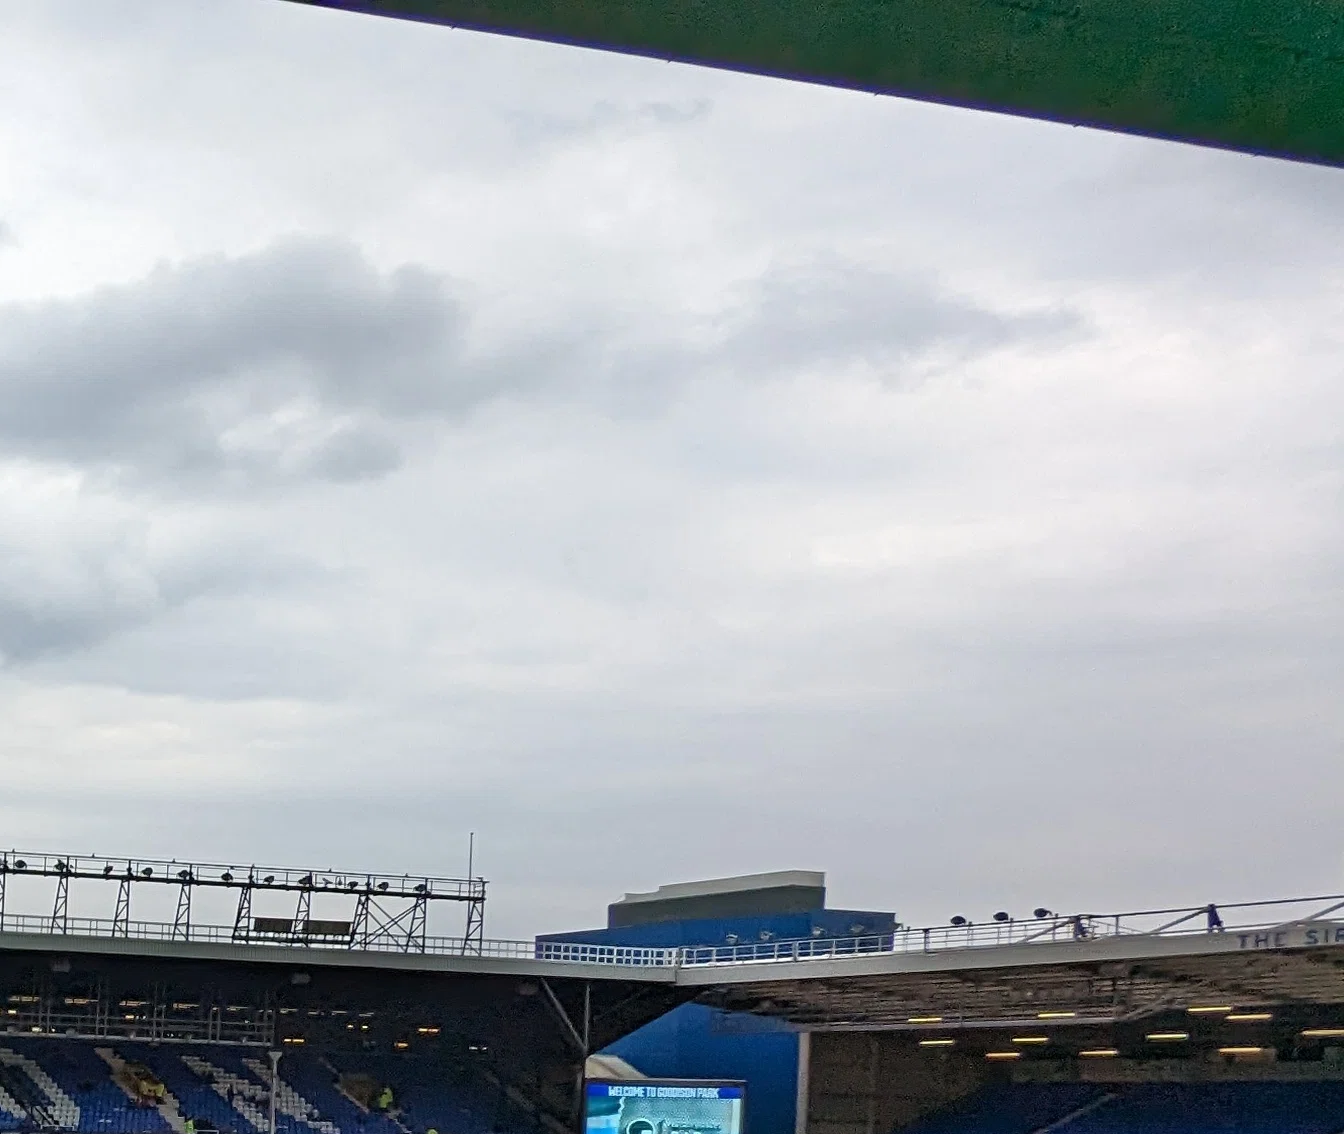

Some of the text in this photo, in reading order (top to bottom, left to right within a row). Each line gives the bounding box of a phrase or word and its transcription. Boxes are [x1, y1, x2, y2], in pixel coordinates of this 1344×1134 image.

[609, 1086, 719, 1098] WELCOME TO GOODISON PARK
